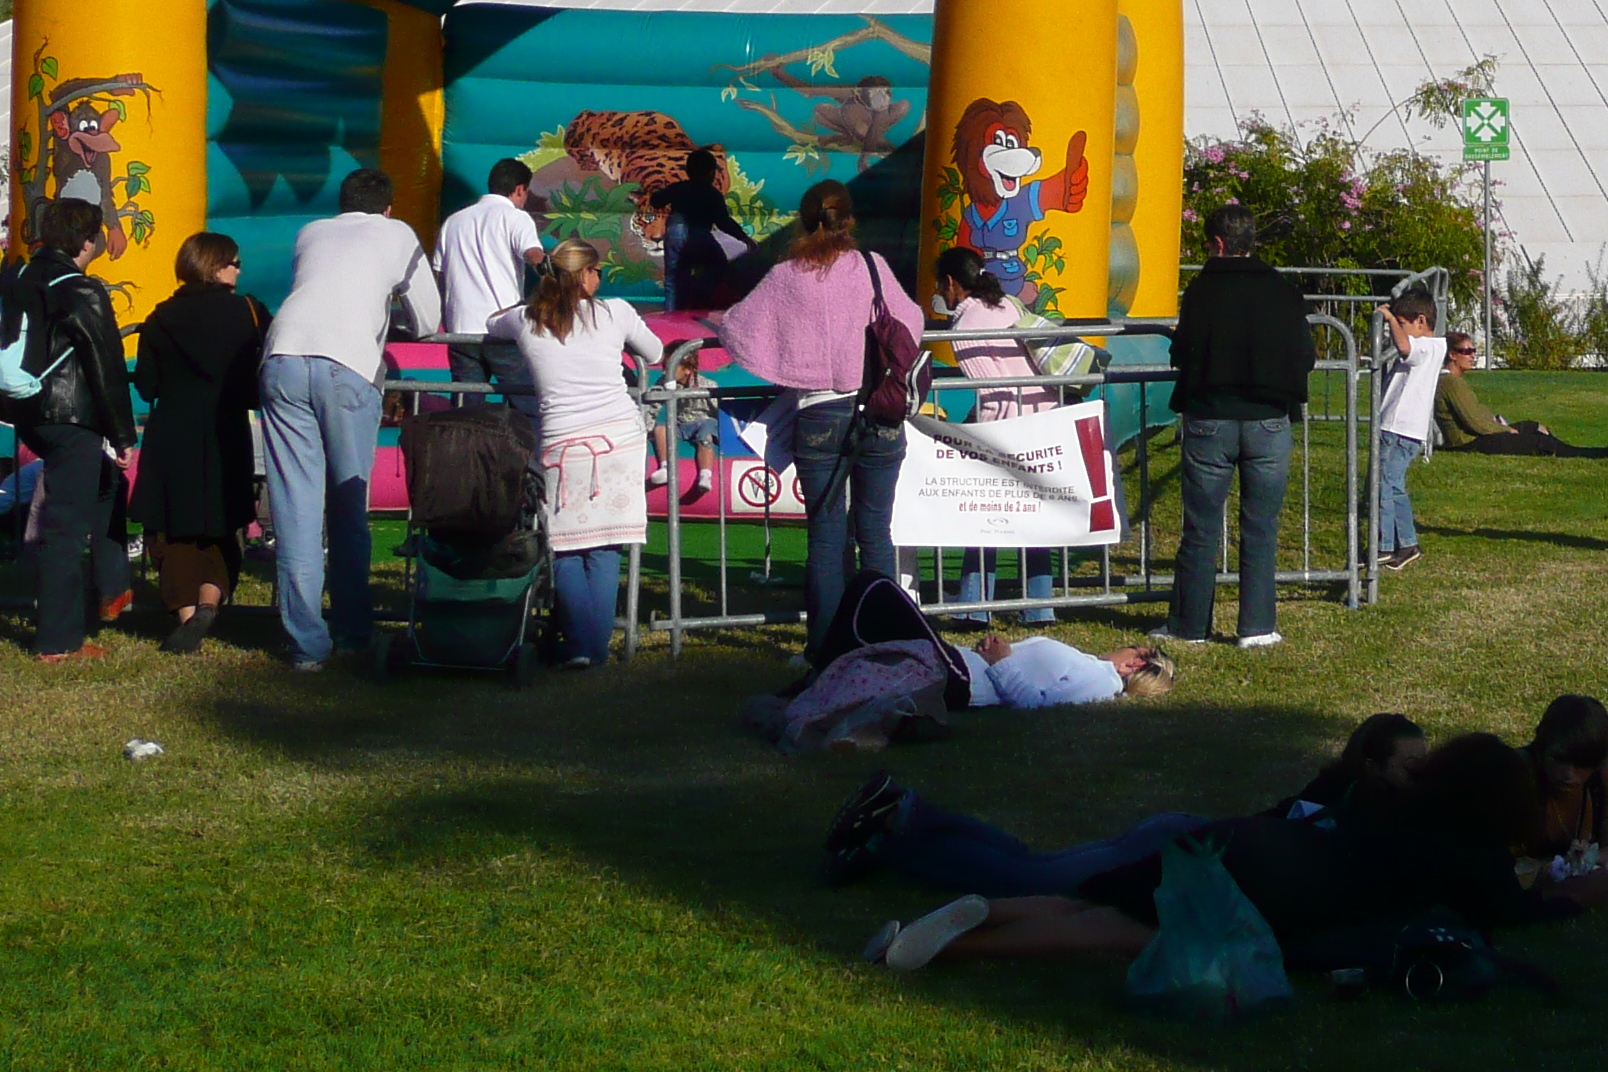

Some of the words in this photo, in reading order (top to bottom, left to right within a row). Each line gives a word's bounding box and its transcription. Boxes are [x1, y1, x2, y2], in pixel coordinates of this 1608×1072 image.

[933, 433, 972, 448] POUR
[997, 445, 1063, 462] SECURITE
[936, 449, 954, 459] DE
[959, 450, 987, 462] VOS
[992, 458, 1055, 474] ENFANTS
[925, 477, 937, 486] LA
[939, 477, 998, 487] STRUCTURE
[1001, 478, 1020, 487] EST
[1022, 481, 1075, 494] INTERDITE
[918, 488, 939, 497] AUX
[942, 488, 986, 498] ENFANTS
[988, 489, 1002, 498] DE
[1004, 489, 1030, 499] PLUS
[1033, 492, 1046, 501] DE
[959, 501, 967, 512] et
[968, 500, 978, 511] de
[979, 500, 1002, 512] moins
[1004, 501, 1013, 512] de
[1015, 501, 1021, 512] 2
[1022, 503, 1036, 512] ans
